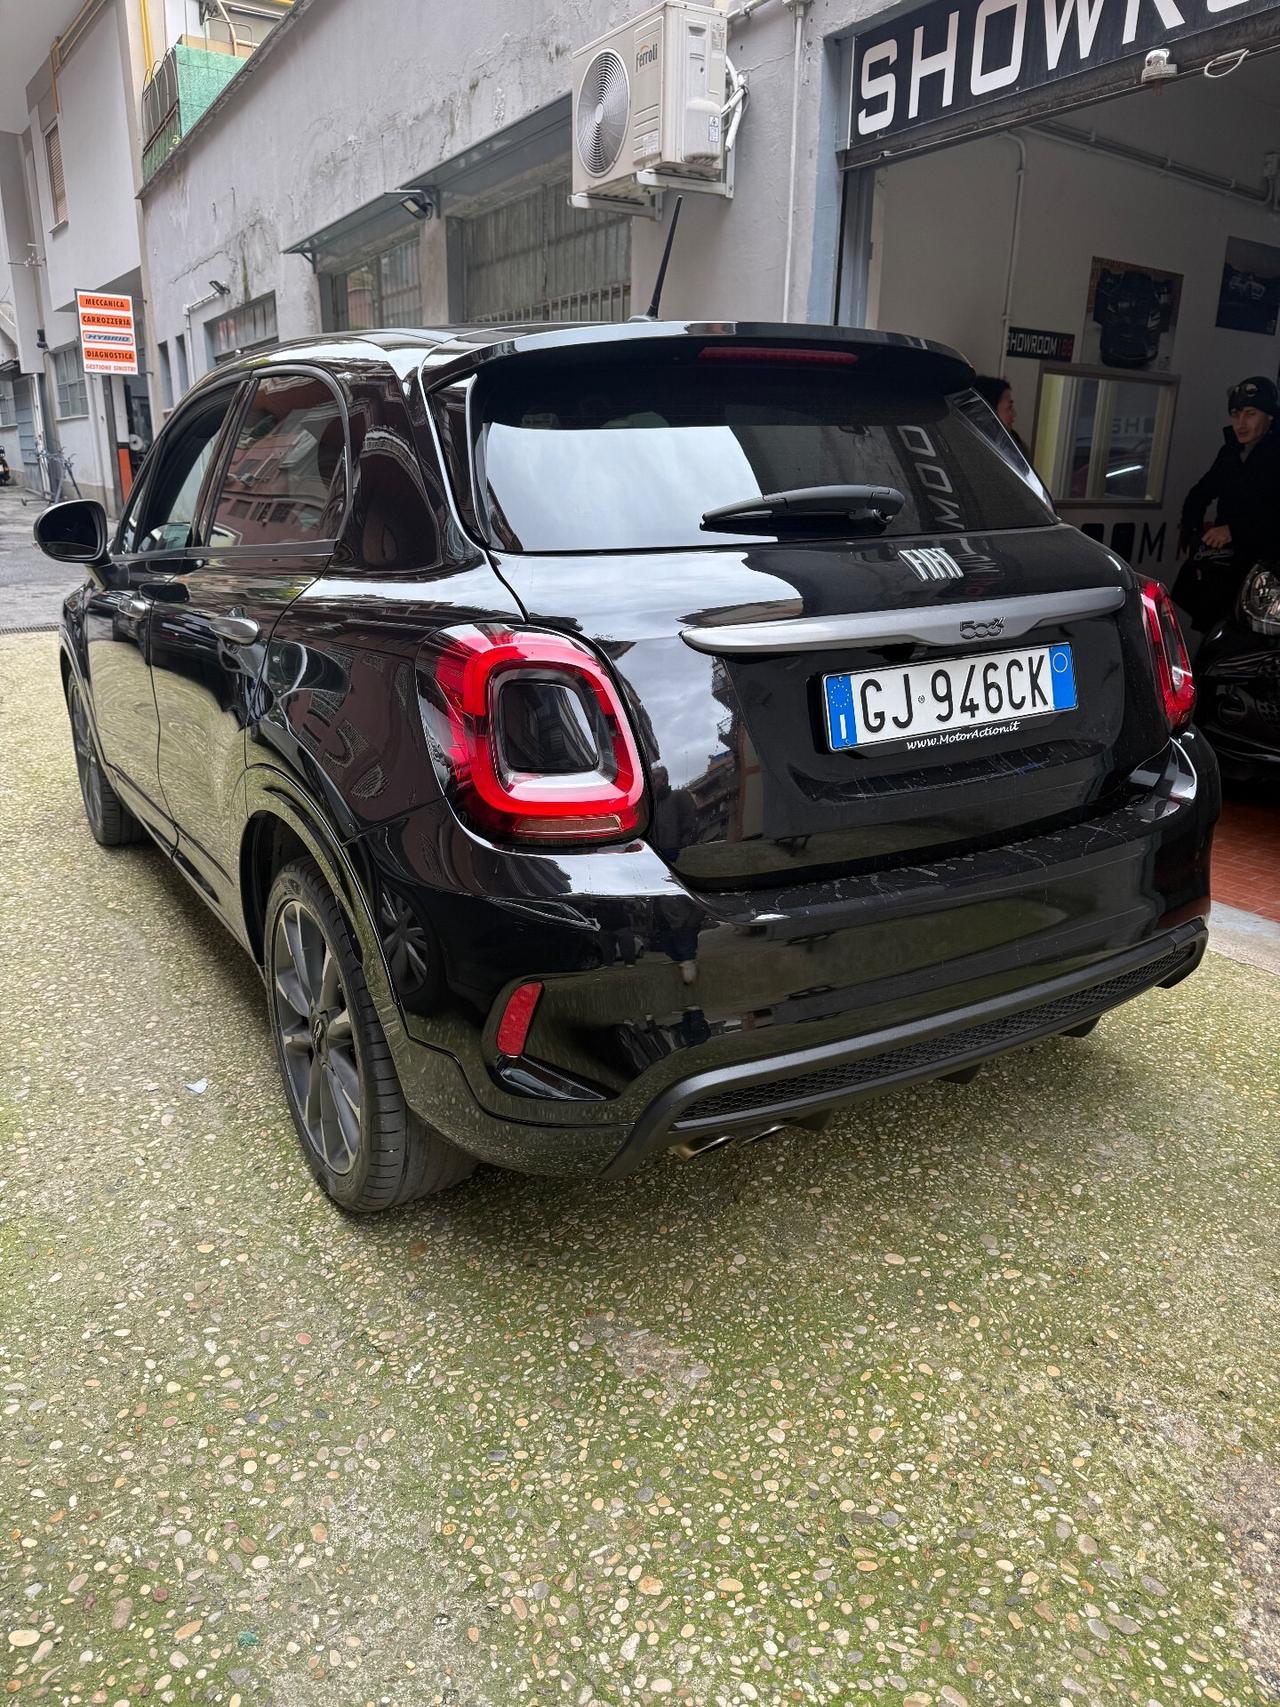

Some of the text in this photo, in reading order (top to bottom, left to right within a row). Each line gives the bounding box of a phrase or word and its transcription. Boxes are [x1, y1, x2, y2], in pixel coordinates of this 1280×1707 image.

[85, 298, 124, 307] MECCANICA
[82, 316, 131, 325] CARROZZERIA
[87, 351, 133, 359] DIAGNOSTICA
[898, 547, 964, 581] FIAT
[906, 720, 1020, 750] www.MotorAction.it
